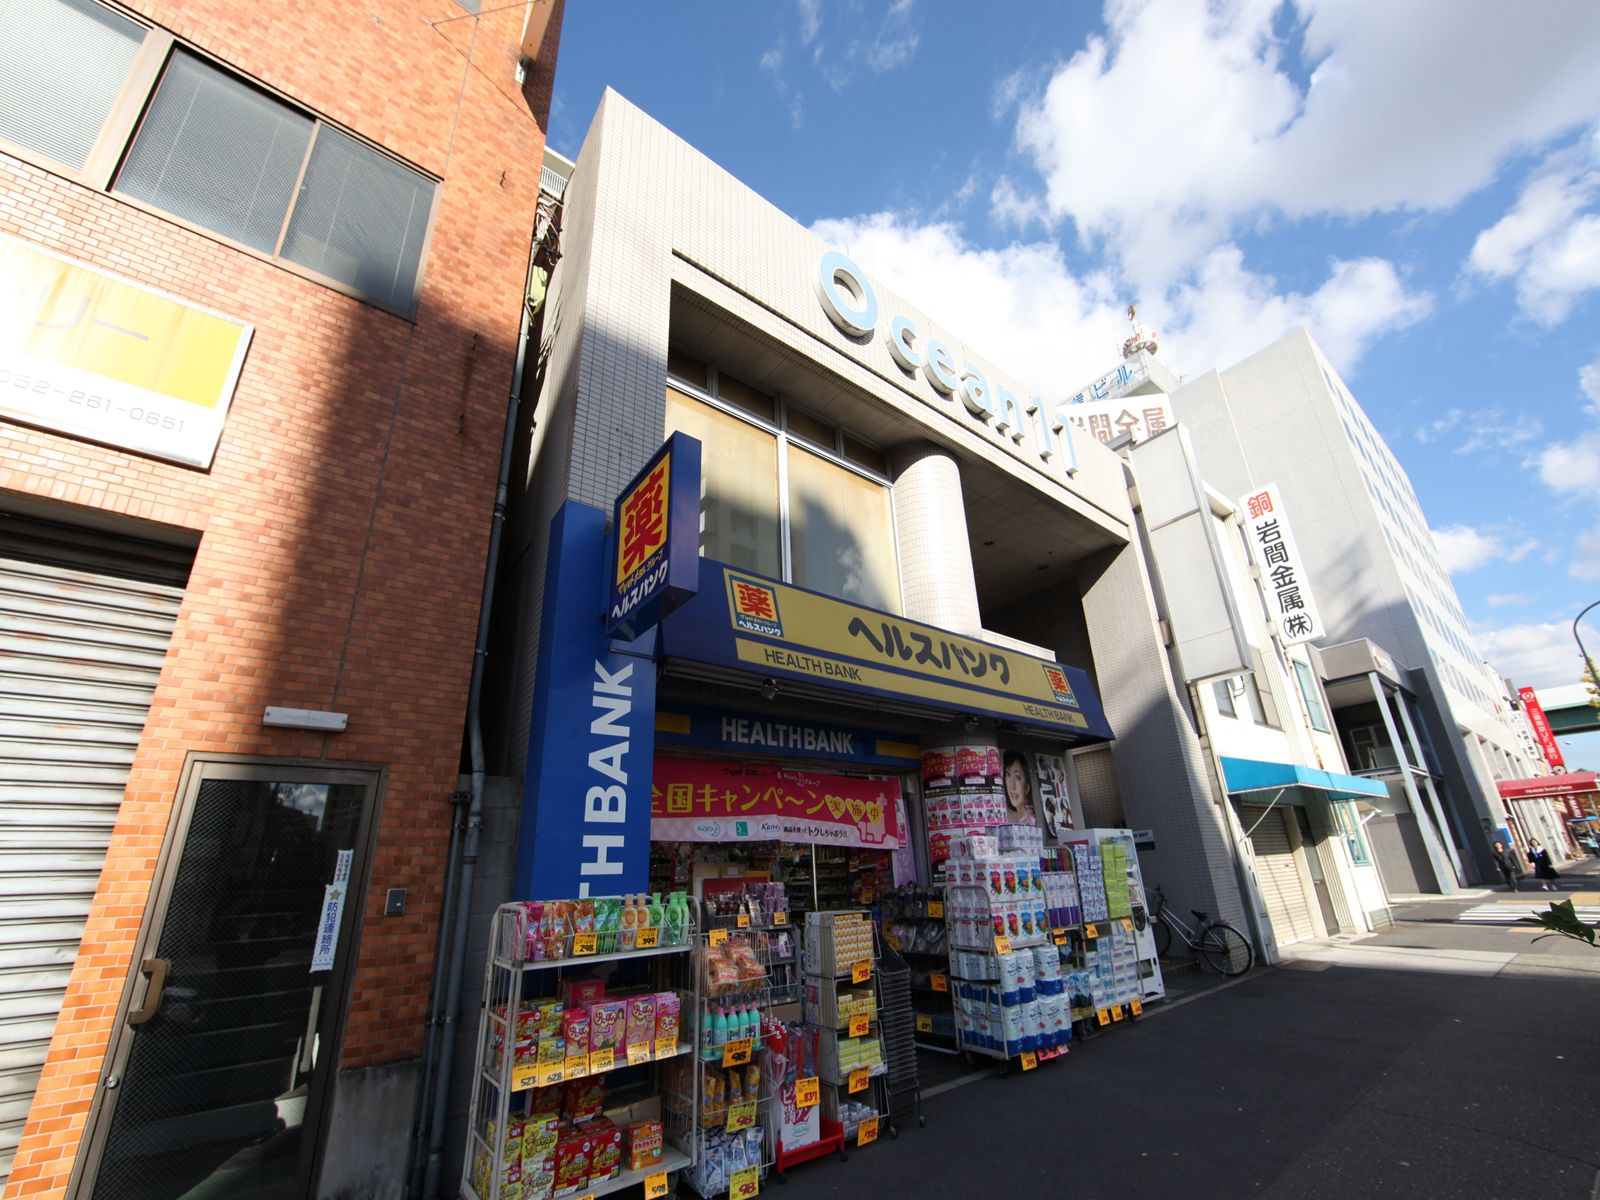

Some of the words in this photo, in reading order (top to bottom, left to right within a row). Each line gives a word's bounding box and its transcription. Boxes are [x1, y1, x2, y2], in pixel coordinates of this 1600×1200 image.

[1069, 407, 1167, 444] 間金属
[623, 465, 664, 575] 薬
[1247, 491, 1274, 520] 銅
[611, 559, 668, 619] ヘルスバンク
[737, 583, 772, 619] 薬
[738, 620, 781, 637] ヘルスバンク
[847, 616, 1011, 686] ヘルスバンク
